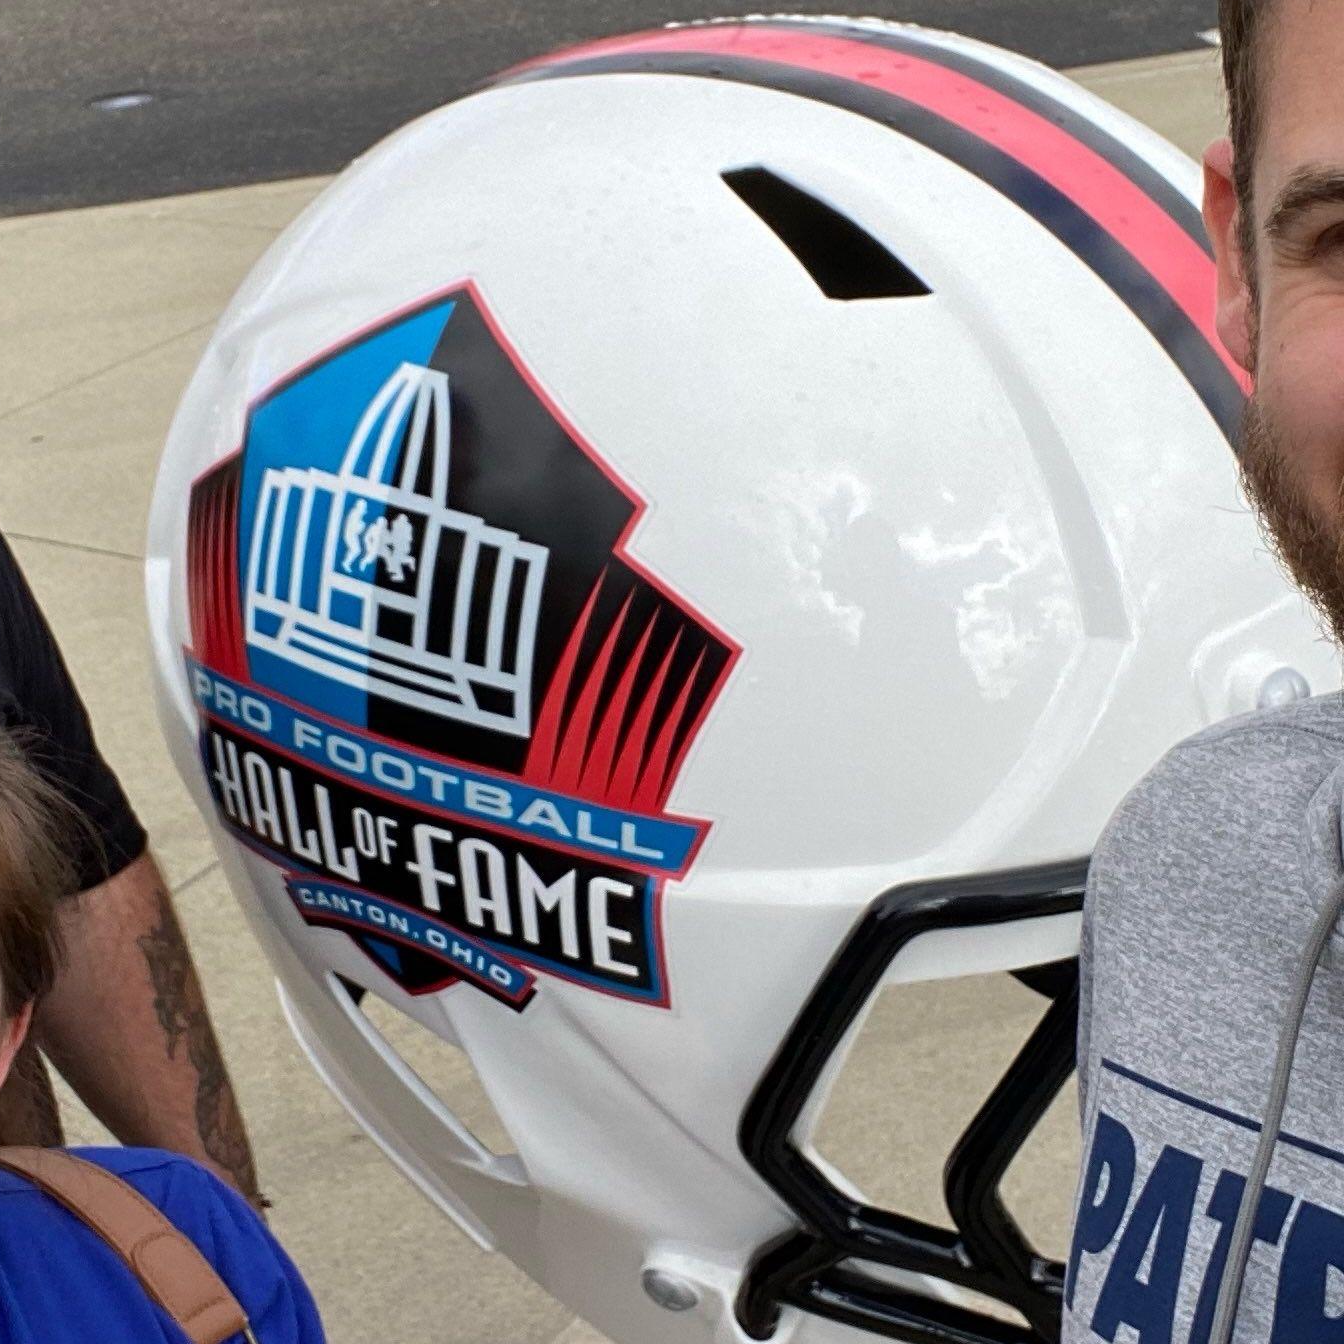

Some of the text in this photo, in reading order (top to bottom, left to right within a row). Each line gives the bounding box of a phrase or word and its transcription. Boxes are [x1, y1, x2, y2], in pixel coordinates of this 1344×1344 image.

[196, 670, 665, 861] PRO FOOTBALL
[213, 732, 639, 979] HALL OF FAME
[425, 927, 513, 989] OHIO
